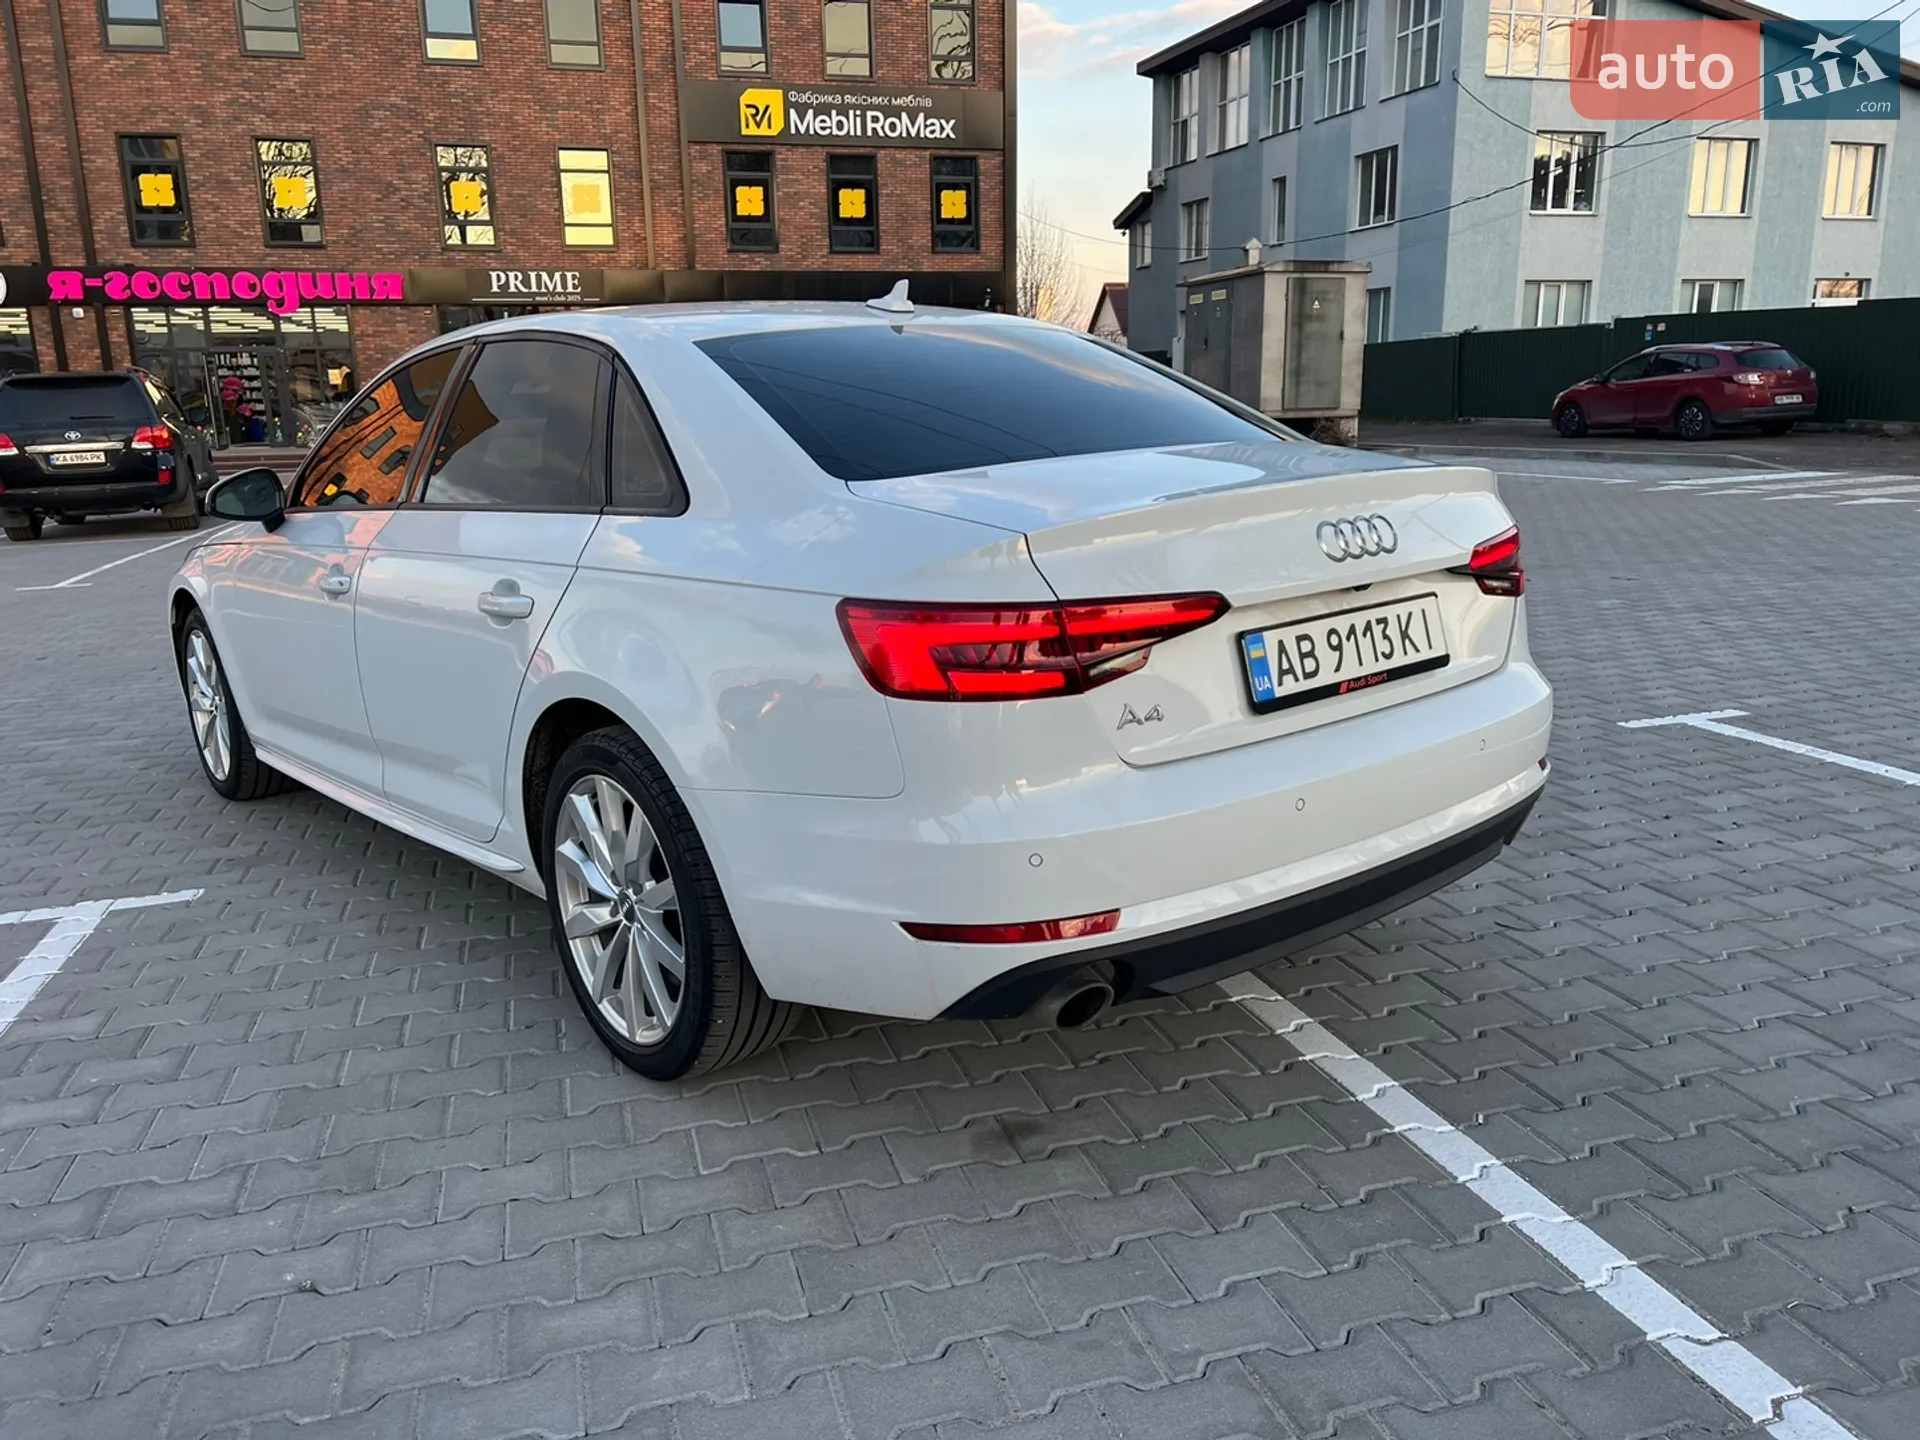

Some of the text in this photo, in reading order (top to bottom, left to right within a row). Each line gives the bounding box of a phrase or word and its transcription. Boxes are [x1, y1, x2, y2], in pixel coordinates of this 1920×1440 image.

[787, 91, 933, 108] Фабрика якісних меблів
[788, 107, 957, 139] Mebli RoMax
[488, 271, 582, 293] PRIME
[1277, 608, 1433, 687] AB 9113 KI
[1254, 674, 1272, 691] UA
[1349, 672, 1388, 689] Audi Sport
[1117, 702, 1166, 731] A4
